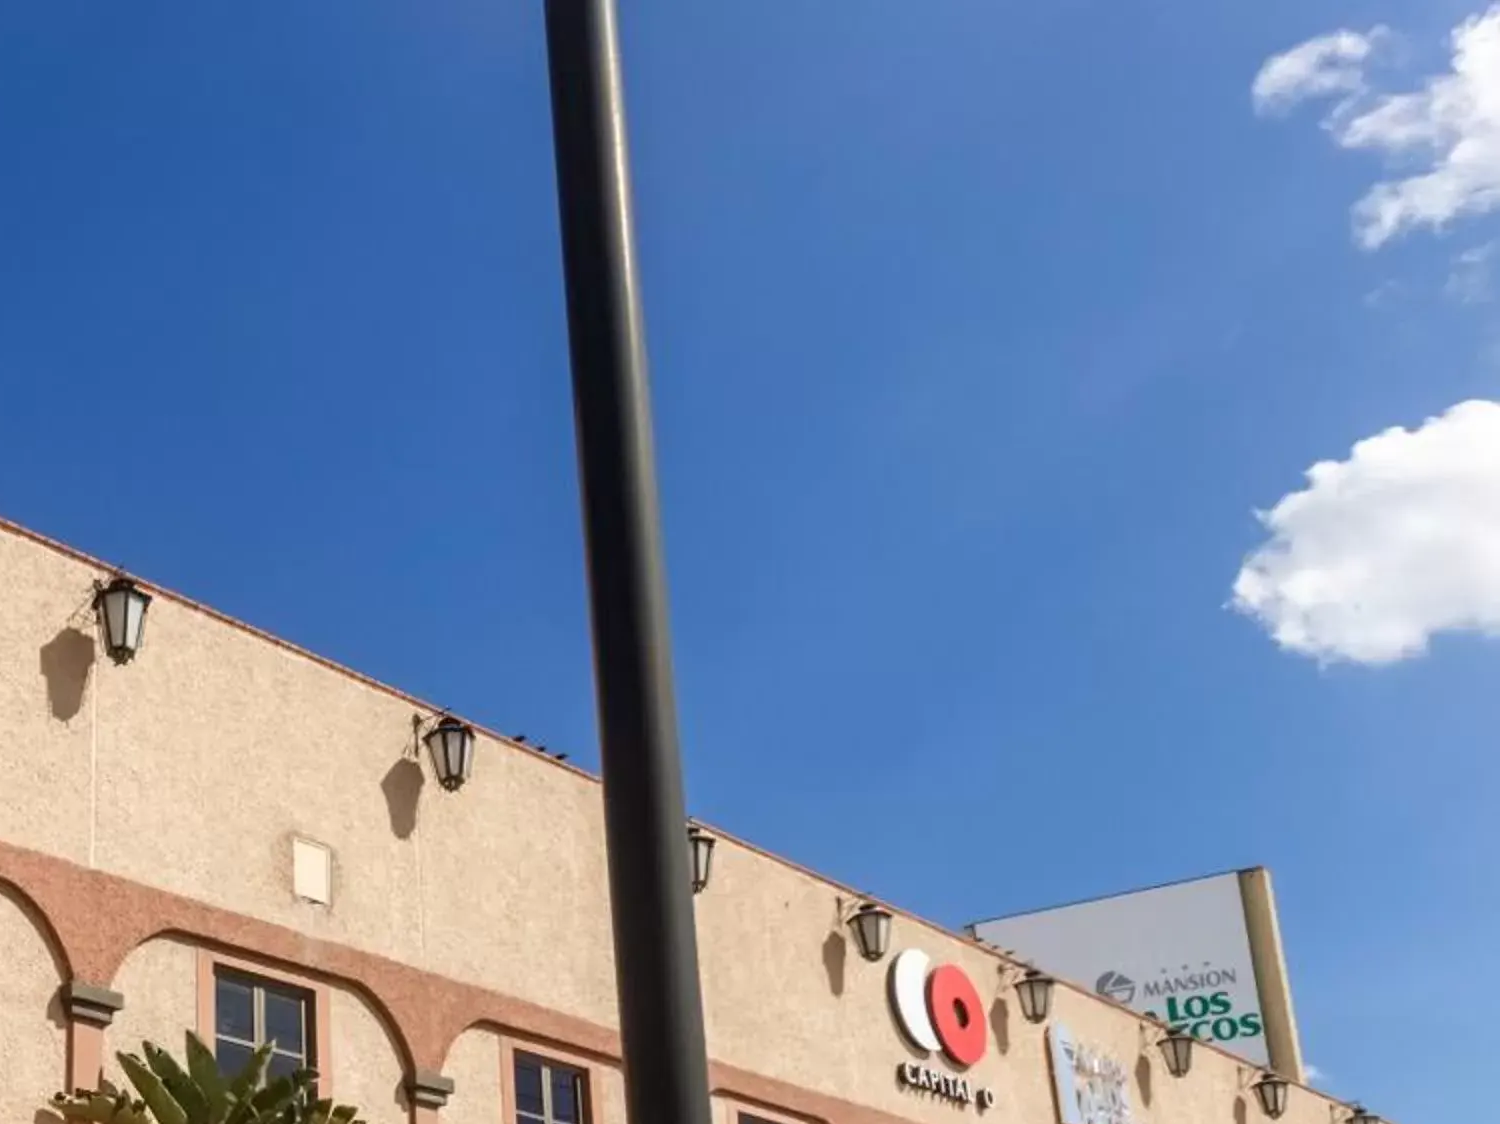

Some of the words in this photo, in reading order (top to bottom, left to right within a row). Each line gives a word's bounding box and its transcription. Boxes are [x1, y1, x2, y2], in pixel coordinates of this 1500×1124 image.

[1167, 992, 1232, 1022] LOS
[1171, 1013, 1262, 1042] COS
[905, 1061, 973, 1104] CAPITAL
